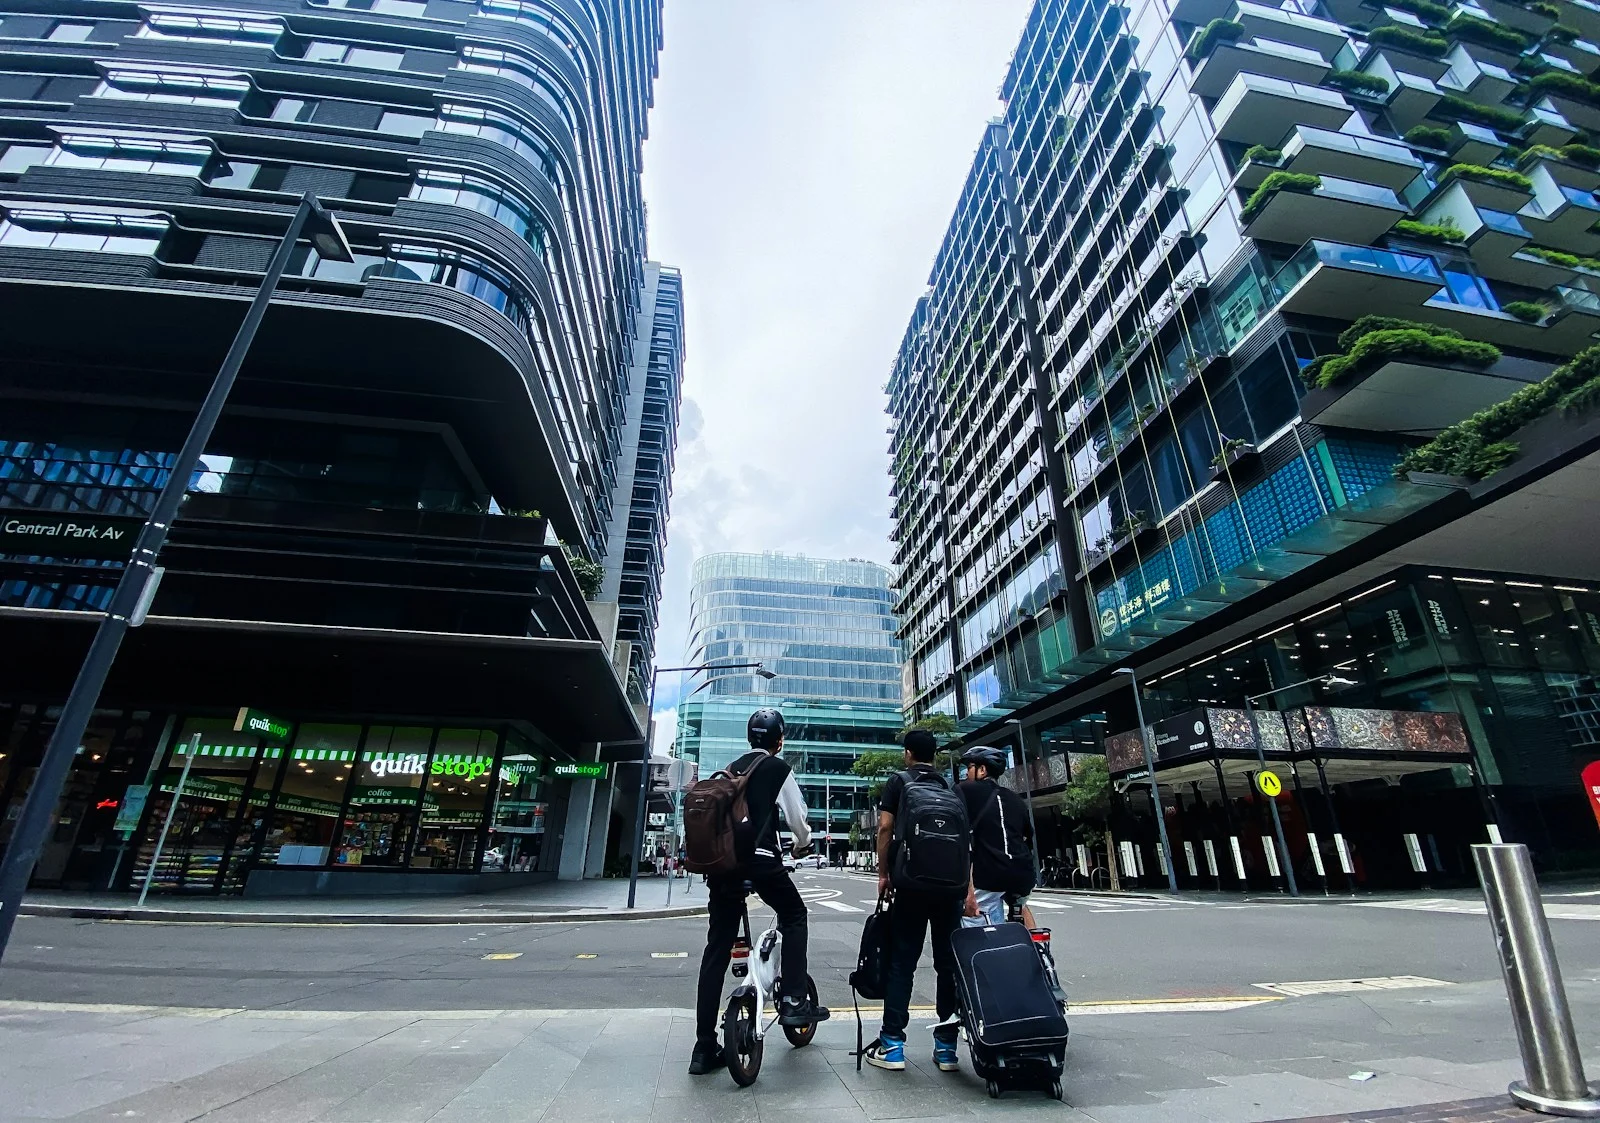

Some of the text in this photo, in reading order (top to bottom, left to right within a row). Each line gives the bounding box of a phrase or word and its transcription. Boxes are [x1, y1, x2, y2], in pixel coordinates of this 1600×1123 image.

[5, 520, 124, 540] Central Park Av
[370, 754, 427, 777] quik
[367, 788, 392, 797] coffee
